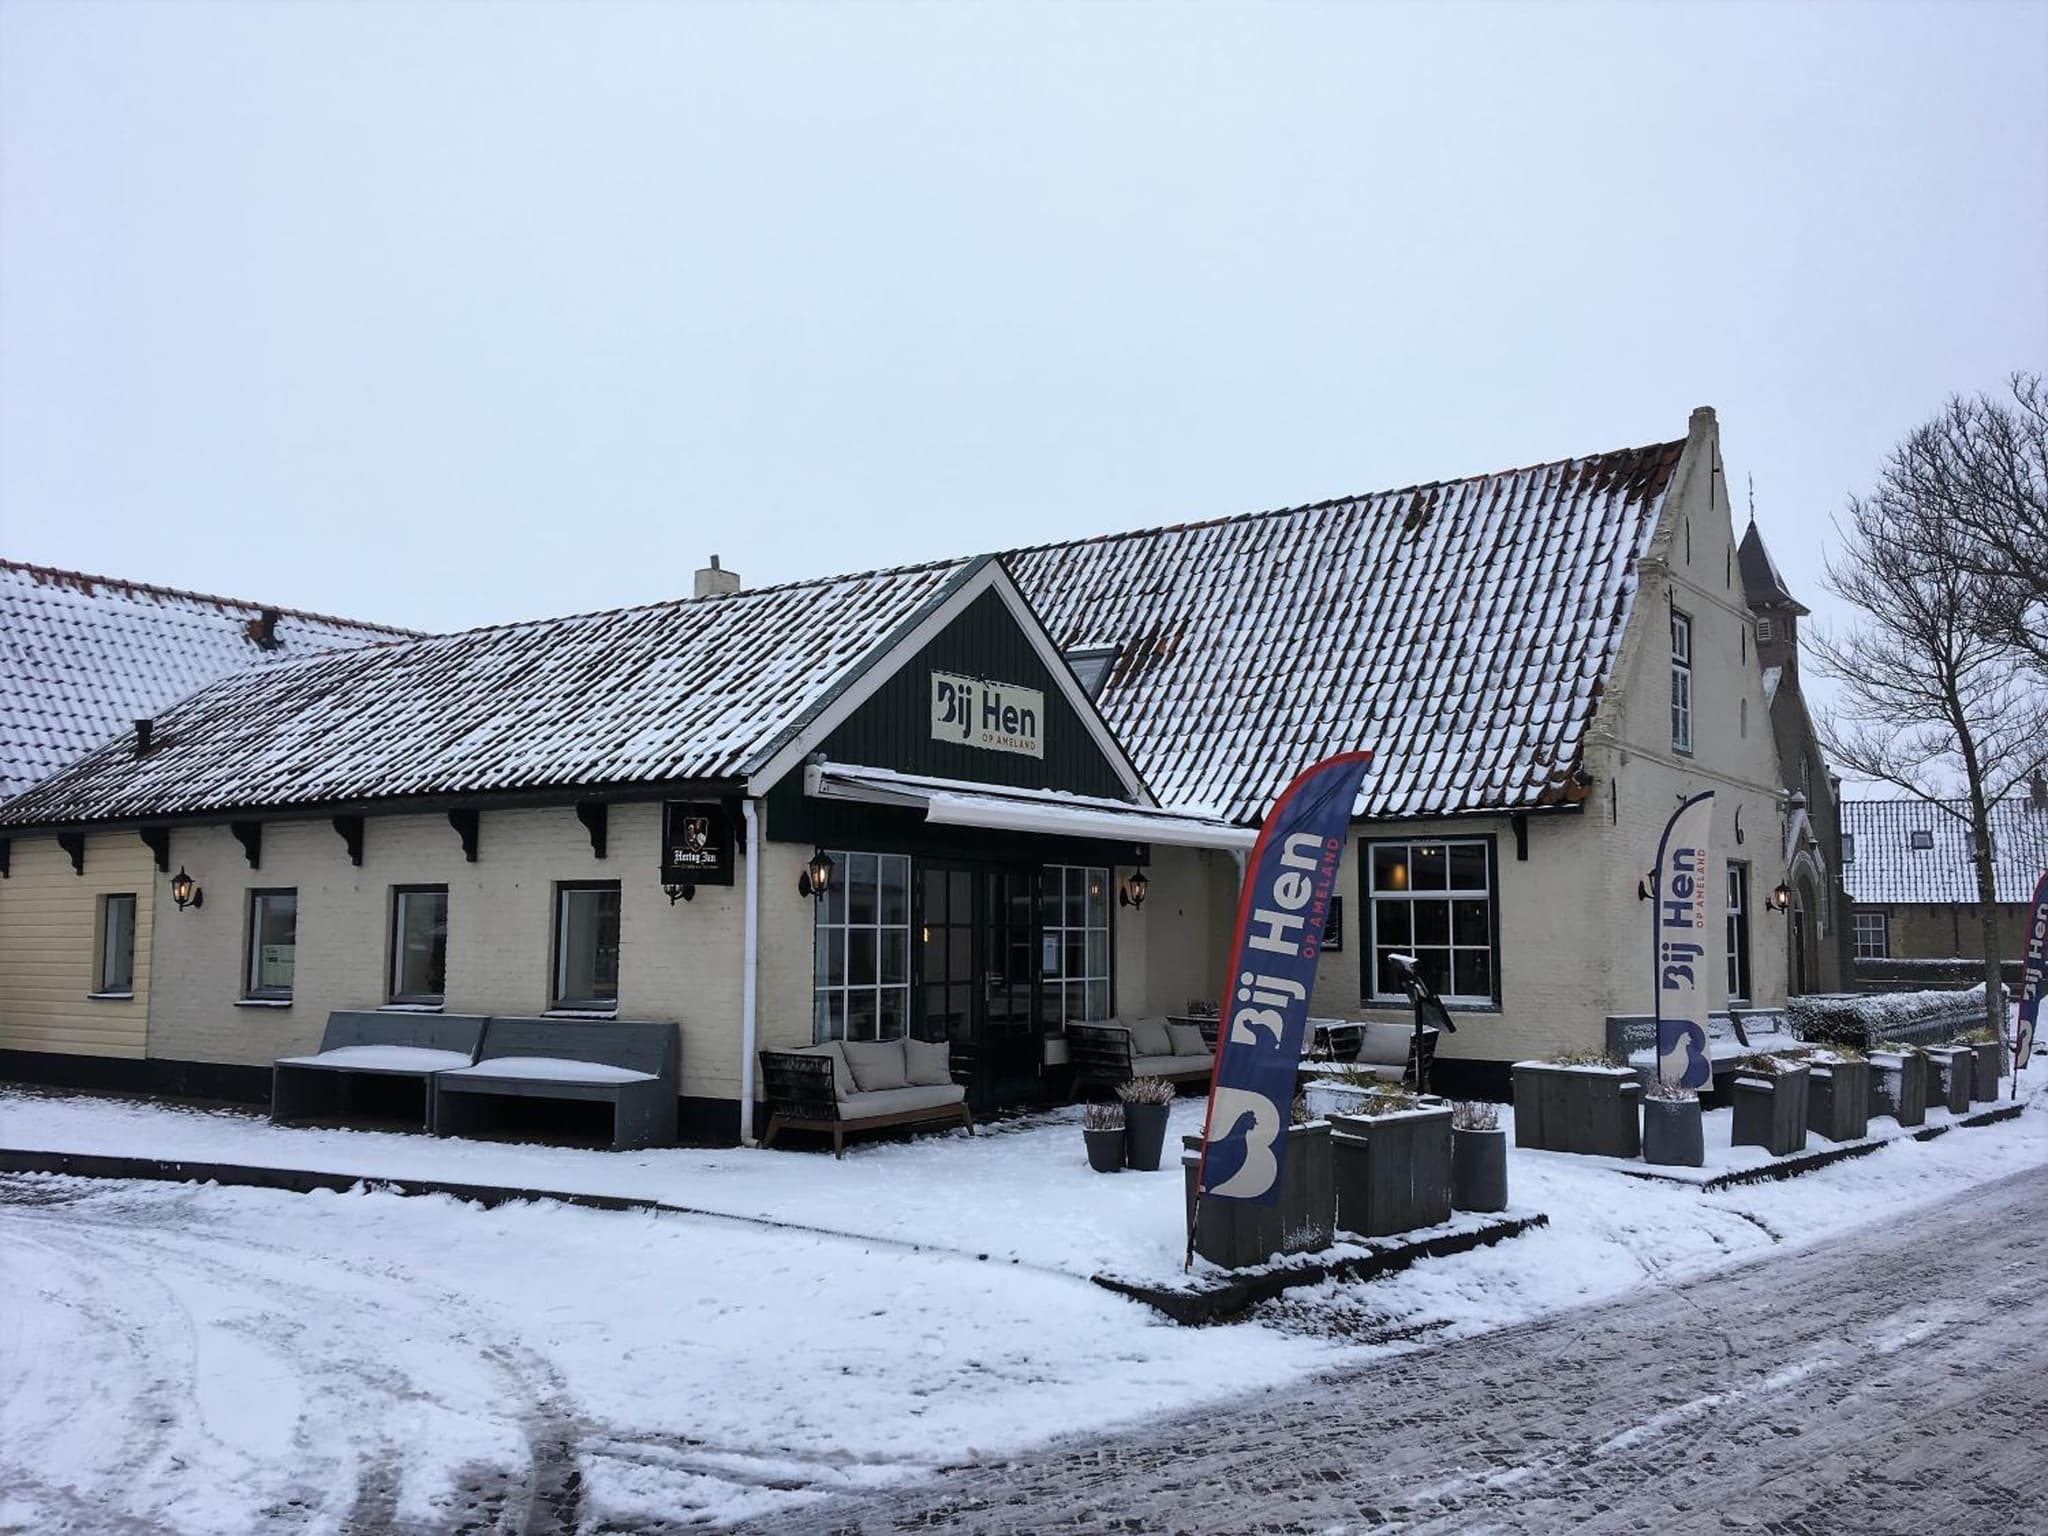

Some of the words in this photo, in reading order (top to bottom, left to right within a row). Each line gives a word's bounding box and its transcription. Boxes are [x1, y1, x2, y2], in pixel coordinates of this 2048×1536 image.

[938, 681, 972, 738] Bij
[982, 690, 1036, 738] Hen
[982, 734, 993, 744] OP
[996, 736, 1036, 751] AMELAND
[1249, 832, 1324, 956] Hen
[1303, 936, 1318, 959] OP
[1314, 838, 1340, 928] AMELAND
[1663, 848, 1696, 928] Hen
[1696, 848, 1706, 908] AMELAND
[1696, 912, 1704, 928] OP
[2028, 903, 2048, 960] Hen
[1662, 942, 1704, 990] Bij
[1230, 972, 1306, 1050] Bij
